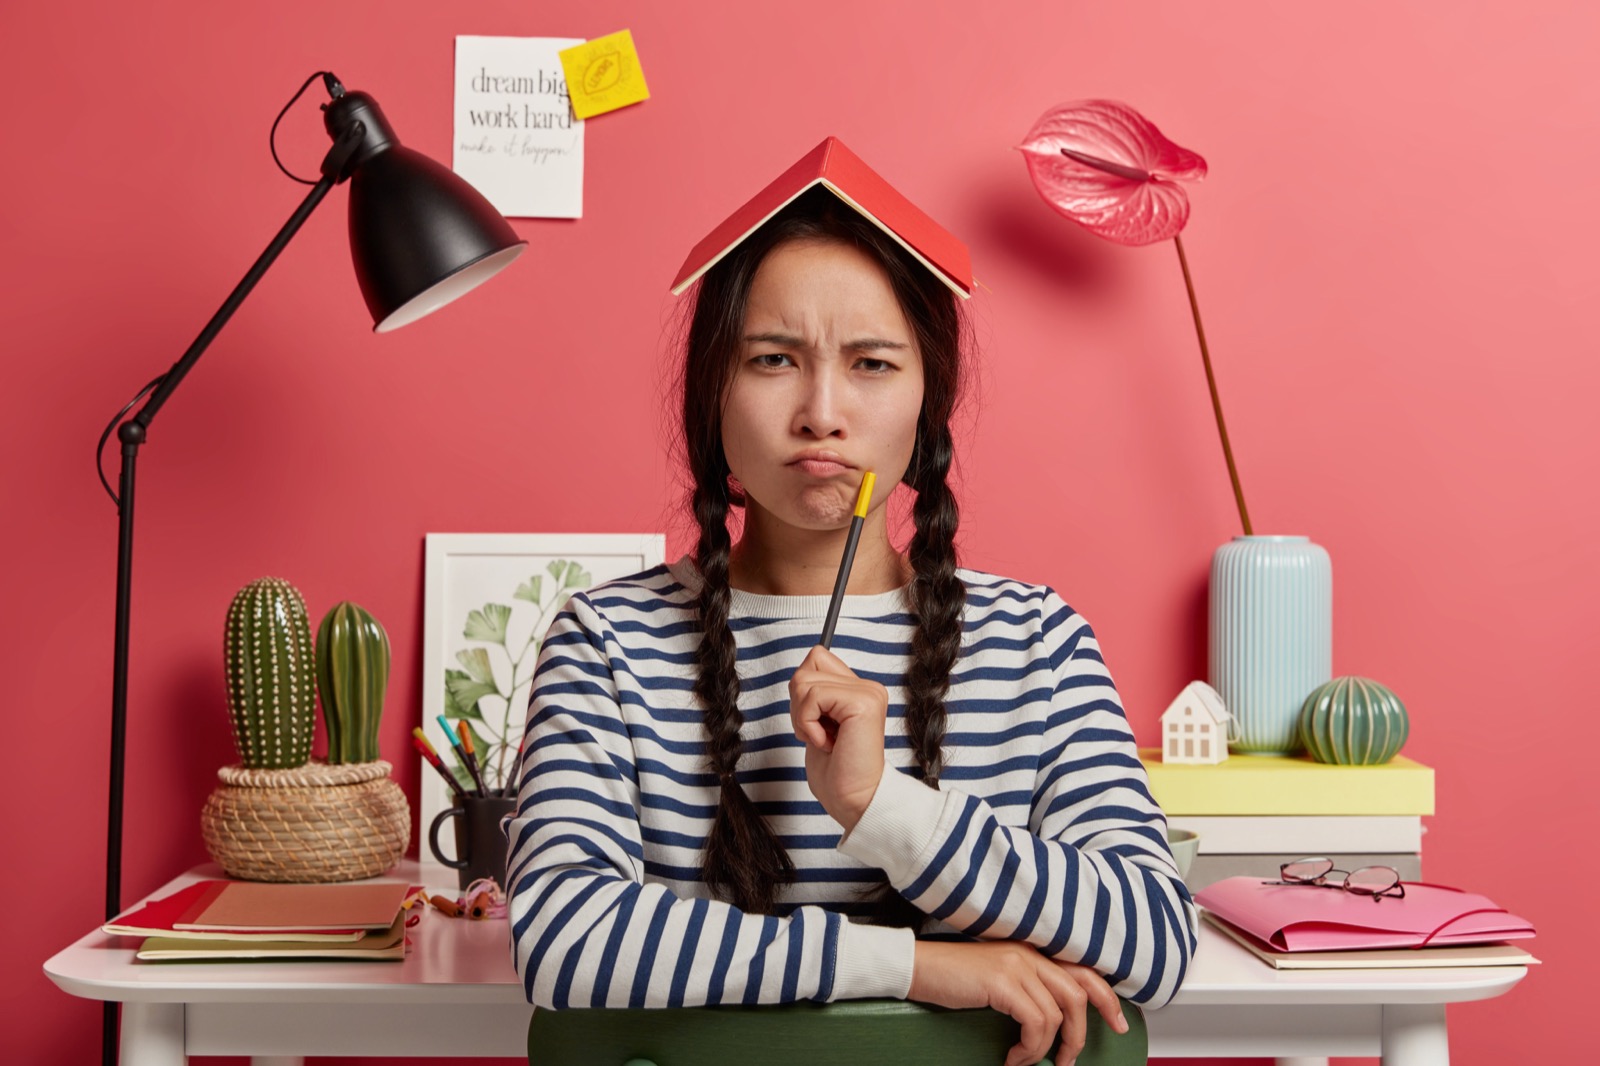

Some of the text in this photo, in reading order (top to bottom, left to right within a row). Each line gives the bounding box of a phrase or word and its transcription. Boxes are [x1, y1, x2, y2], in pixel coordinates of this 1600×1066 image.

[472, 67, 533, 93] dream
[470, 103, 572, 129] work hard
[460, 136, 495, 154] make
[504, 134, 517, 157] it
